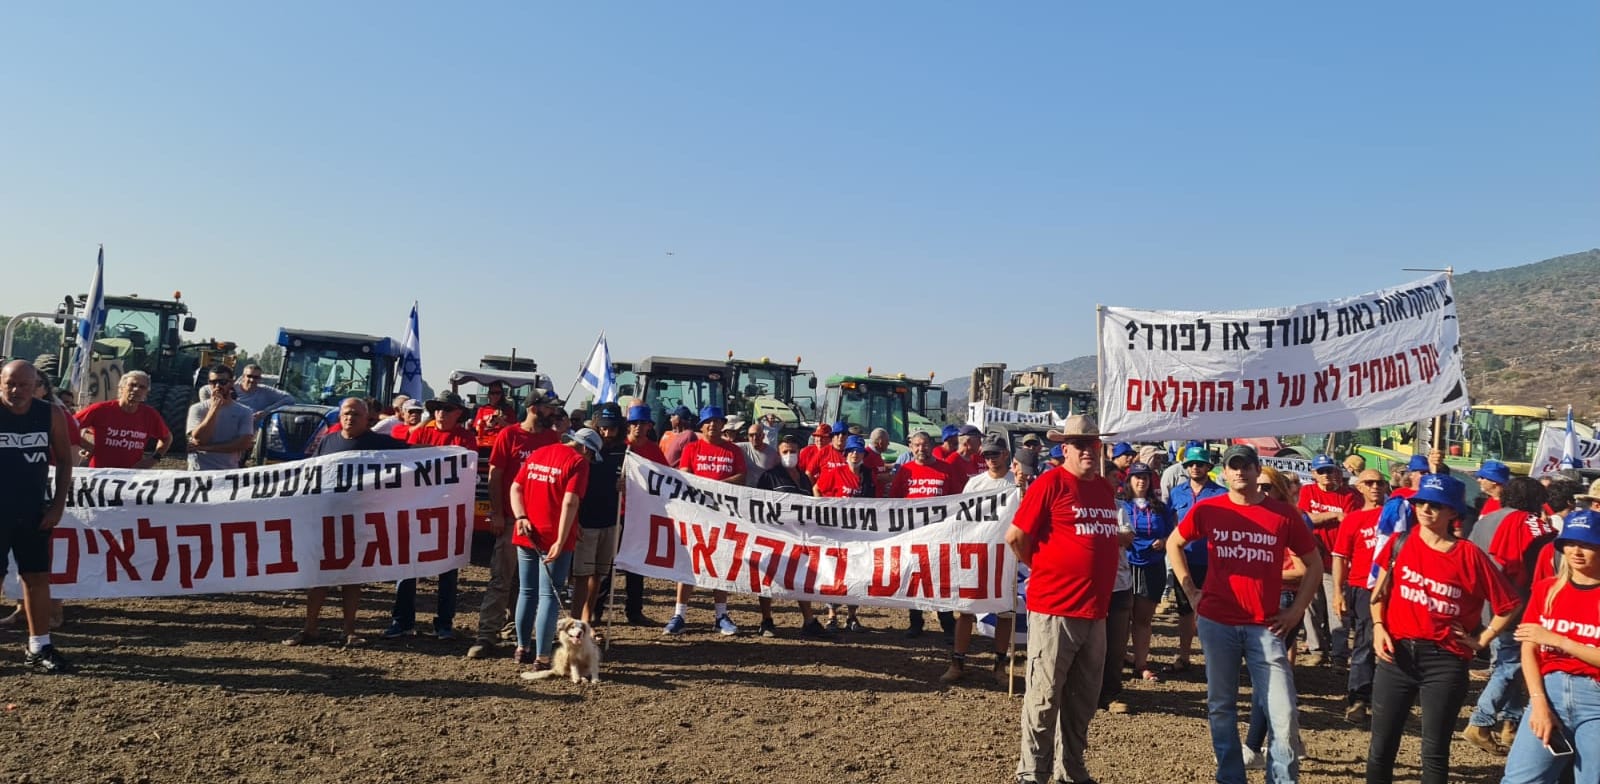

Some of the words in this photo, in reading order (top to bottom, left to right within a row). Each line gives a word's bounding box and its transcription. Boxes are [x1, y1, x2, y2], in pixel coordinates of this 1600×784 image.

[1125, 319, 1211, 351] לפורר?
[1223, 322, 1250, 350] או
[1259, 309, 1329, 348] לעודד
[1278, 372, 1305, 407] על
[1313, 364, 1341, 403] לא
[1348, 352, 1411, 398] המחיה
[1126, 375, 1234, 417] החקלאים
[1241, 378, 1269, 411] גב
[107, 426, 119, 436] על
[225, 464, 322, 500] מעשיר
[333, 463, 401, 493] פרוע
[414, 454, 467, 487] יבוא
[166, 476, 212, 504] את
[790, 505, 878, 532] מעשיר
[889, 505, 947, 532] פרוע
[956, 493, 1007, 522] יבוא
[1072, 506, 1088, 519] על
[319, 503, 466, 571] ופוגע
[1213, 528, 1229, 541] על
[1232, 530, 1277, 545] שומרים
[48, 518, 298, 589] בחקלאים
[644, 514, 848, 596] בחקלאים
[1216, 545, 1274, 563] החקלאות
[868, 543, 1005, 600] ופוגע
